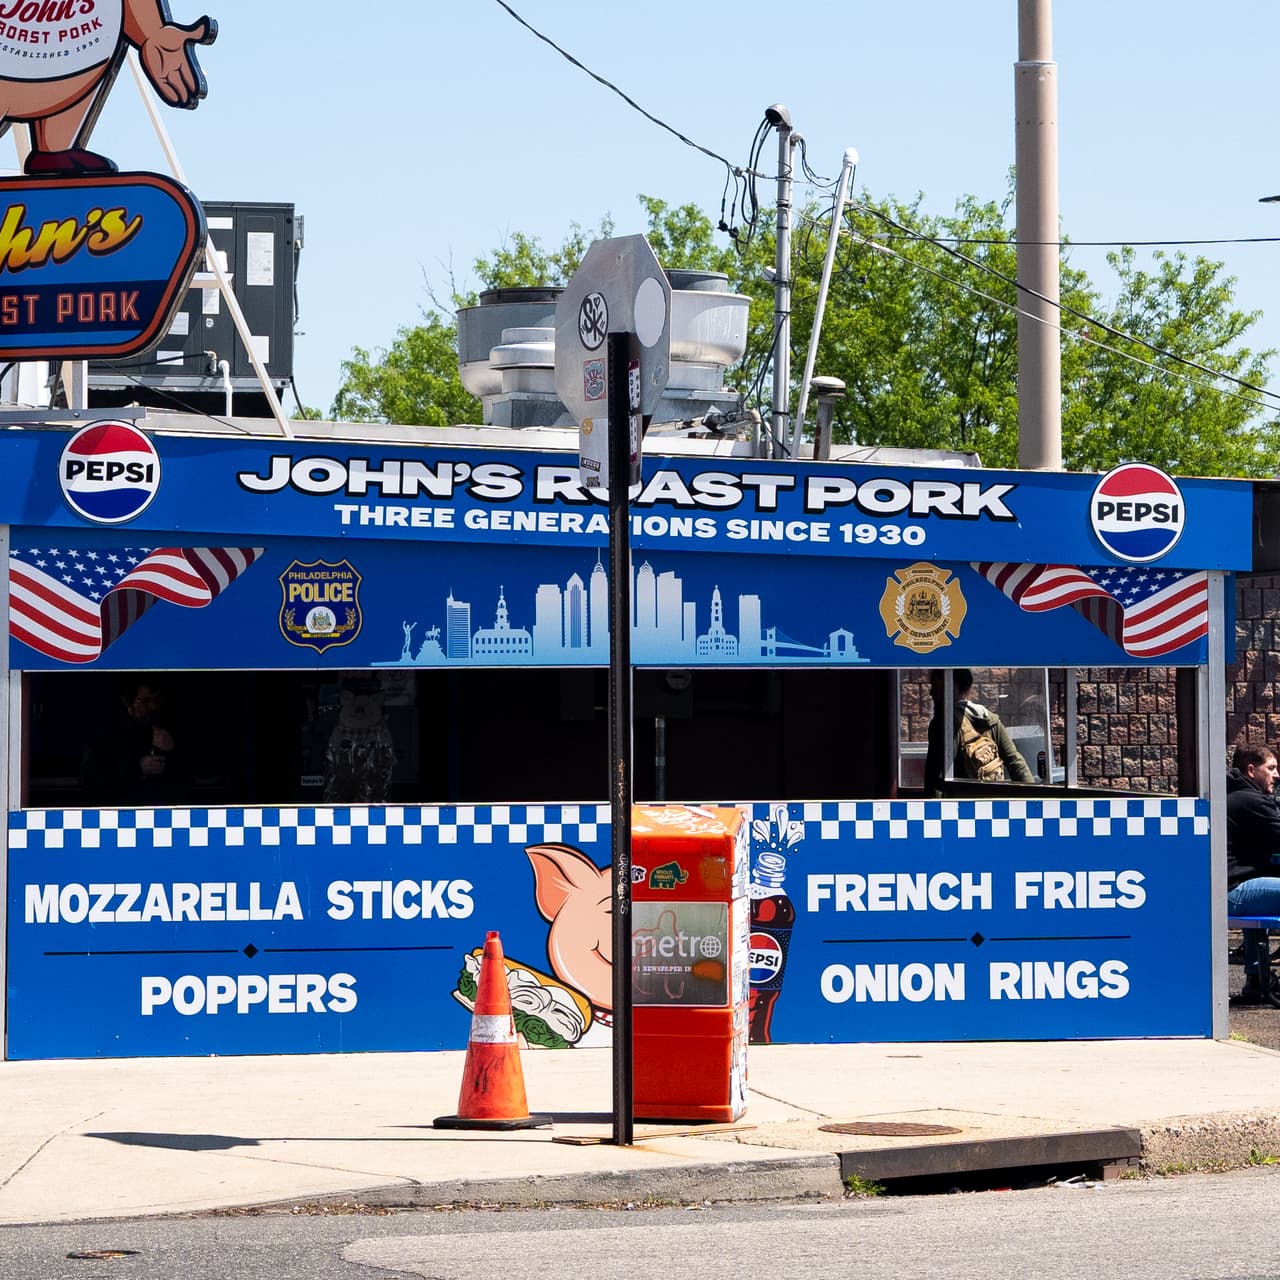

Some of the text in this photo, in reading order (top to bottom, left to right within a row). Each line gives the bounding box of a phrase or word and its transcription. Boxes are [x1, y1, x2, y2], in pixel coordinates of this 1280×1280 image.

[58, 17, 104, 44] PORK
[75, 37, 100, 52] 1930
[56, 289, 140, 323] PORK
[65, 458, 154, 485] PEPSI
[239, 455, 1017, 521] JOHN'S RAST PORK
[334, 504, 927, 547] THREE GENERAIONS SINCE 1930
[1097, 501, 1180, 524] PEPSI
[288, 571, 353, 580] PHILADELPHIA
[289, 582, 354, 603] POLICE
[24, 879, 475, 924] MOZZARELLA STICKS
[806, 869, 1146, 913] FRENCH FRIES
[632, 930, 722, 958] metro
[748, 951, 779, 968] EPSI
[140, 972, 358, 1017] POPPERS
[820, 959, 1131, 1004] ONION RINGS
